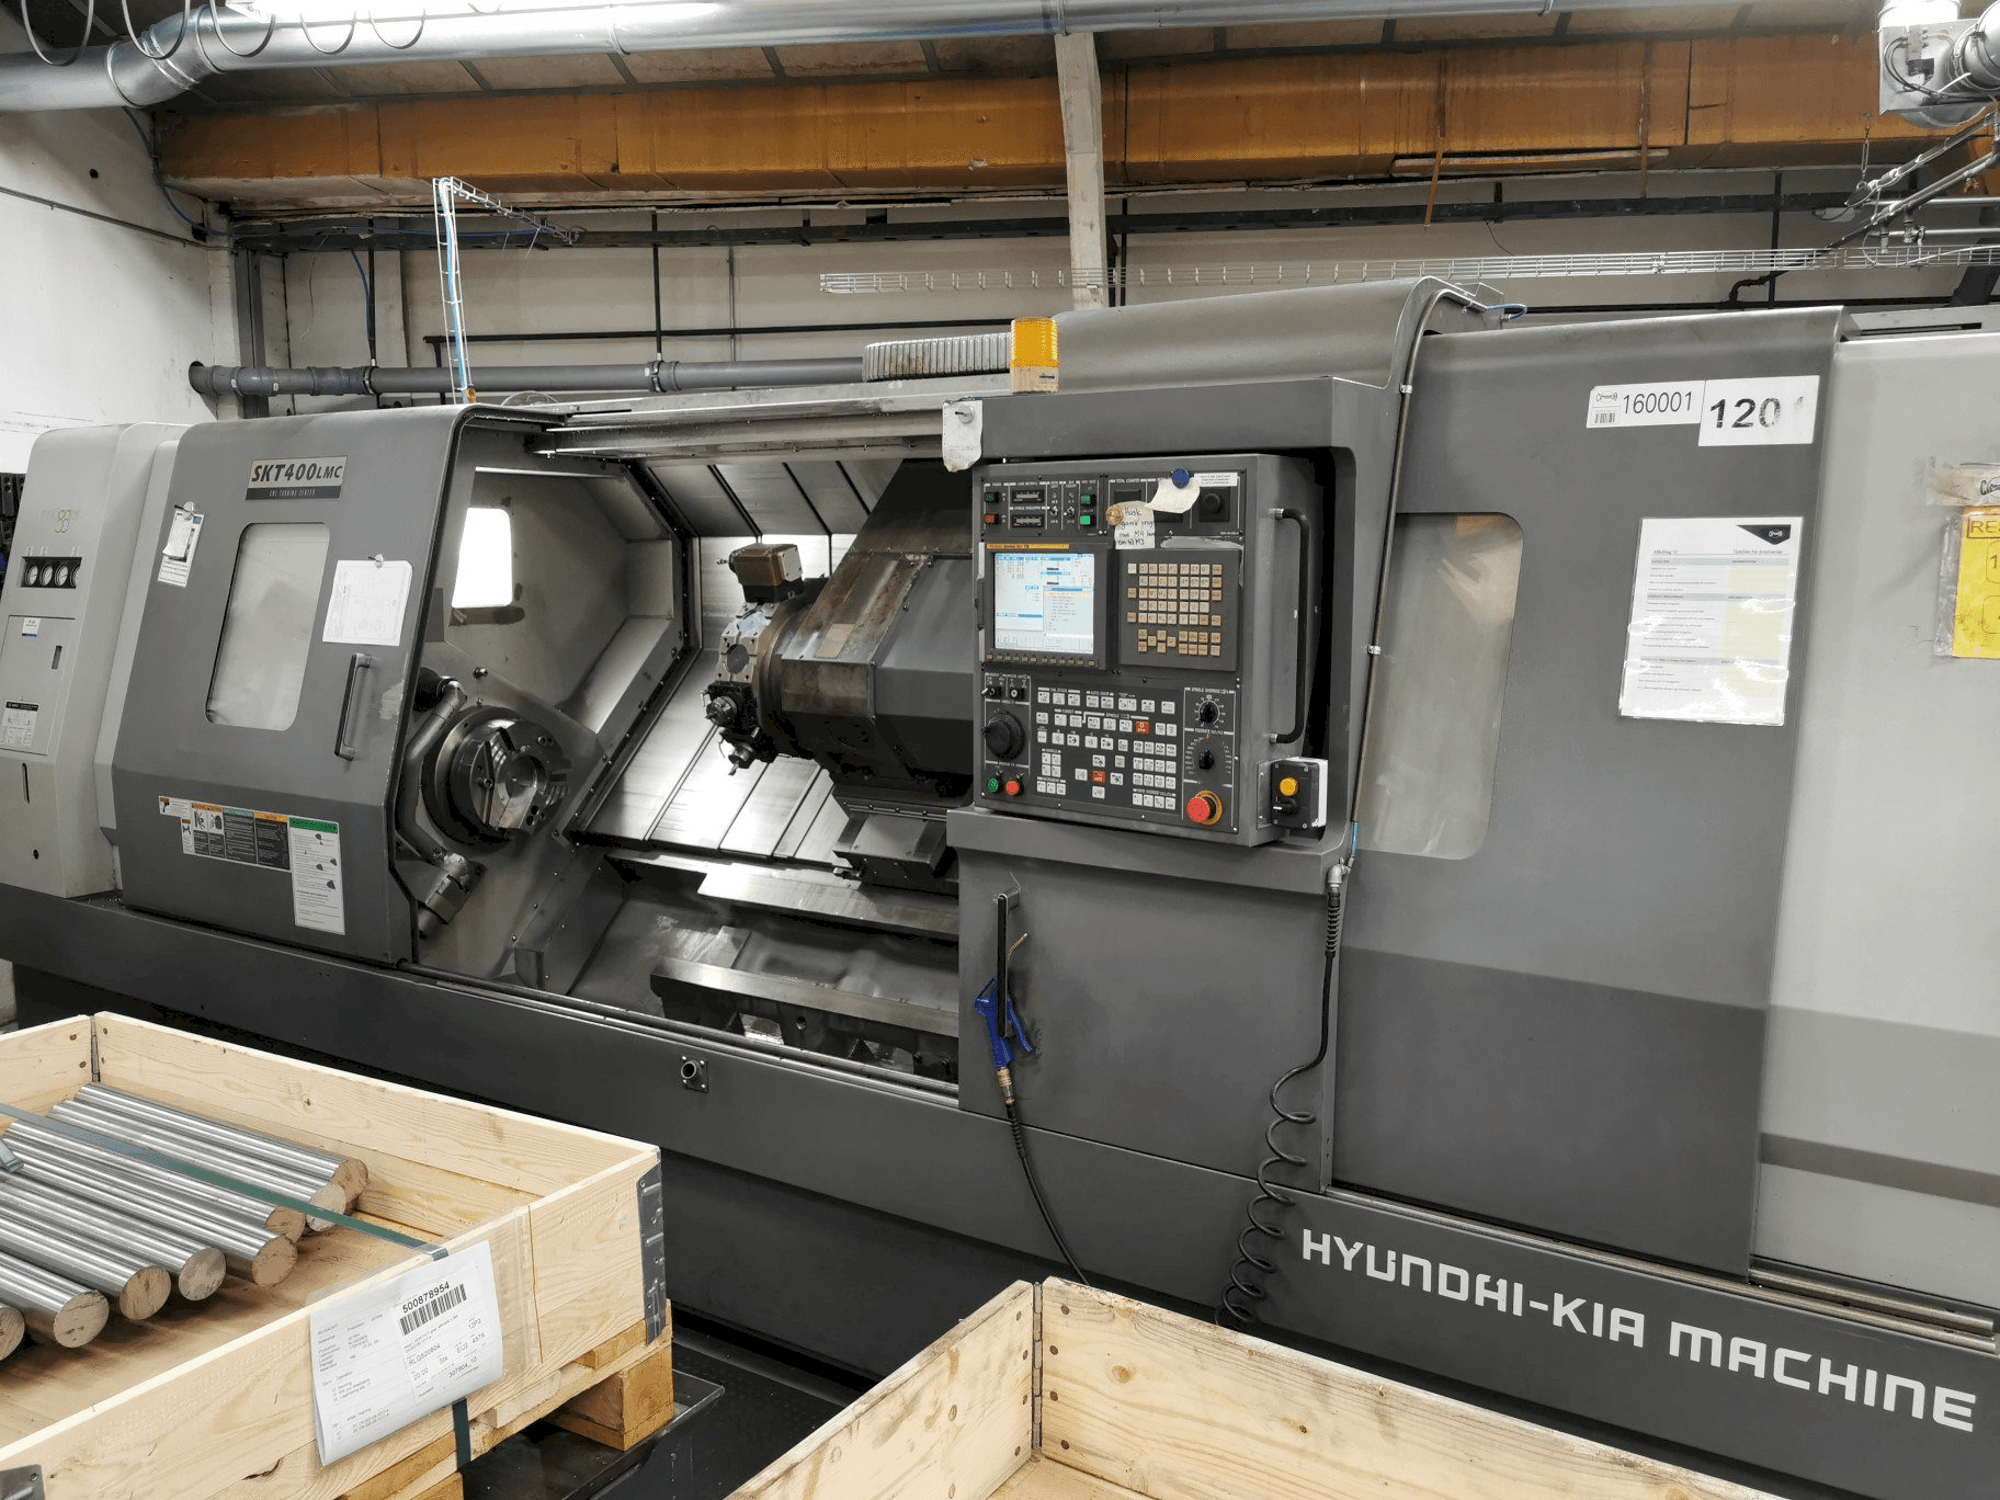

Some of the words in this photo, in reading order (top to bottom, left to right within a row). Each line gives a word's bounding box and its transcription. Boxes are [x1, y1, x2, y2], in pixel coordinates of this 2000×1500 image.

[1623, 391, 1692, 414] 160001
[251, 463, 343, 482] SKT400LMC
[1970, 520, 2000, 534] RE
[402, 1281, 450, 1313] 500878954
[1303, 1228, 1645, 1348] HYUNDAI-KIA
[1669, 1321, 1977, 1432] MACHINE
